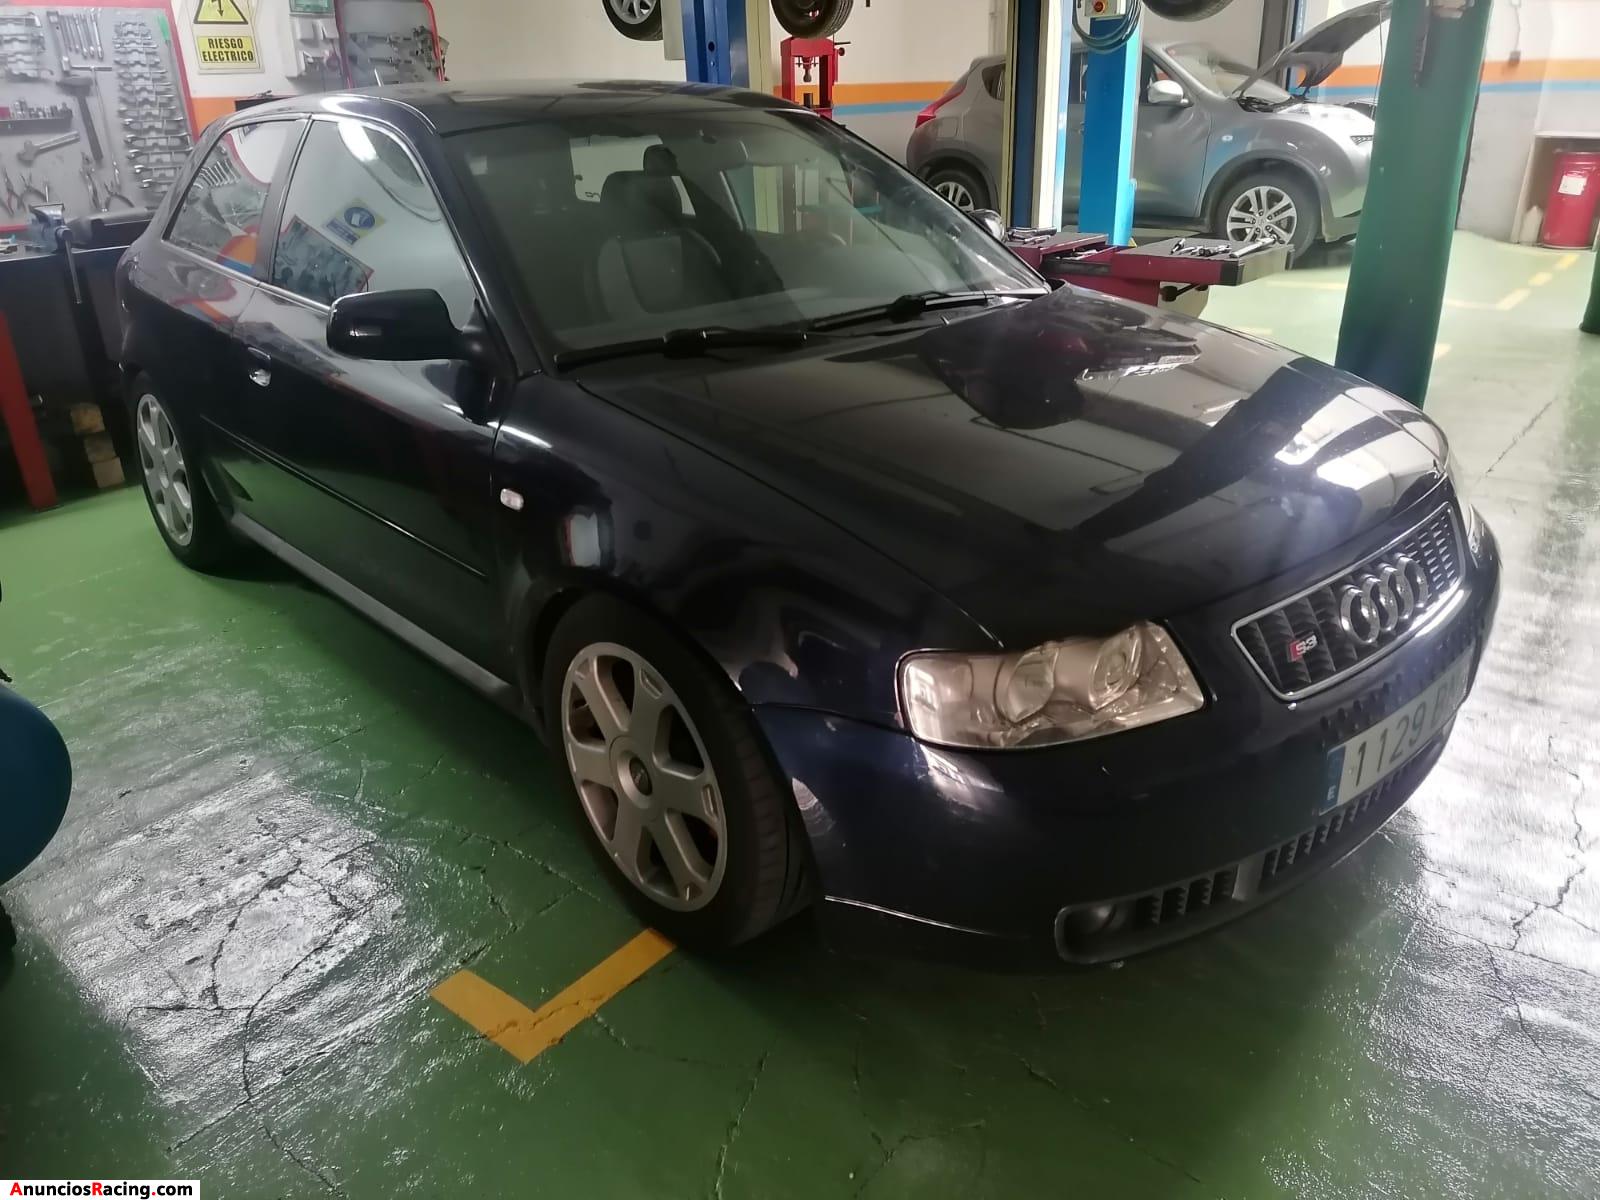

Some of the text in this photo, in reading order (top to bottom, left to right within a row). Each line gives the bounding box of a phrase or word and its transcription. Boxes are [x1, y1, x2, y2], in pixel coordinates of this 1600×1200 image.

[208, 38, 243, 49] RIESGO
[202, 51, 254, 62] ELECTRICO
[1295, 634, 1318, 656] S3
[1356, 701, 1427, 787] 1129
